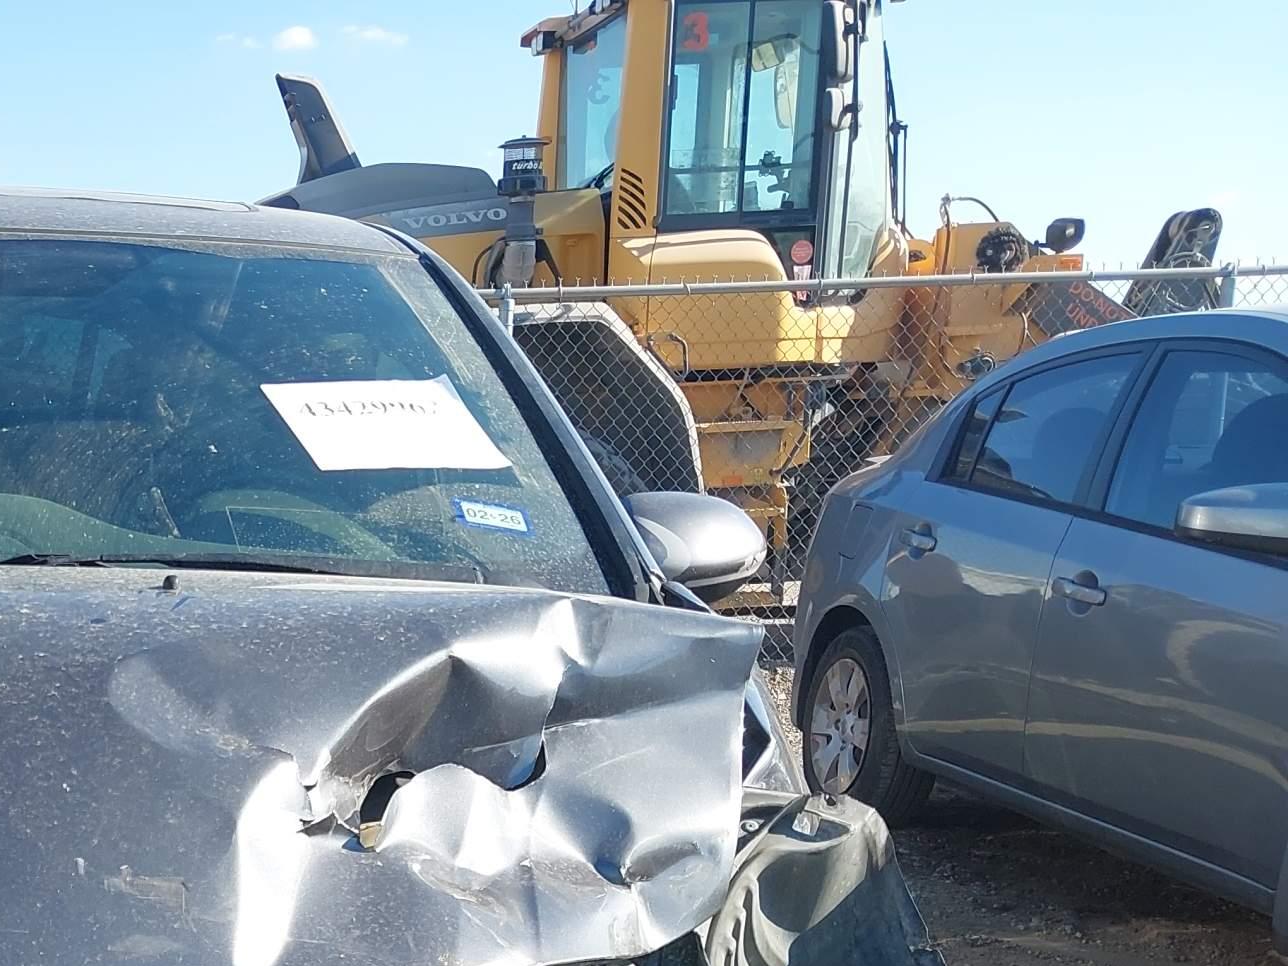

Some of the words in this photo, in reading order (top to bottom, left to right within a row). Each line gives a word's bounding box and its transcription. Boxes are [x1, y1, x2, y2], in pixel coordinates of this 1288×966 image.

[682, 11, 709, 51] 3
[512, 160, 538, 170] turbo
[403, 207, 508, 229] VOLVO
